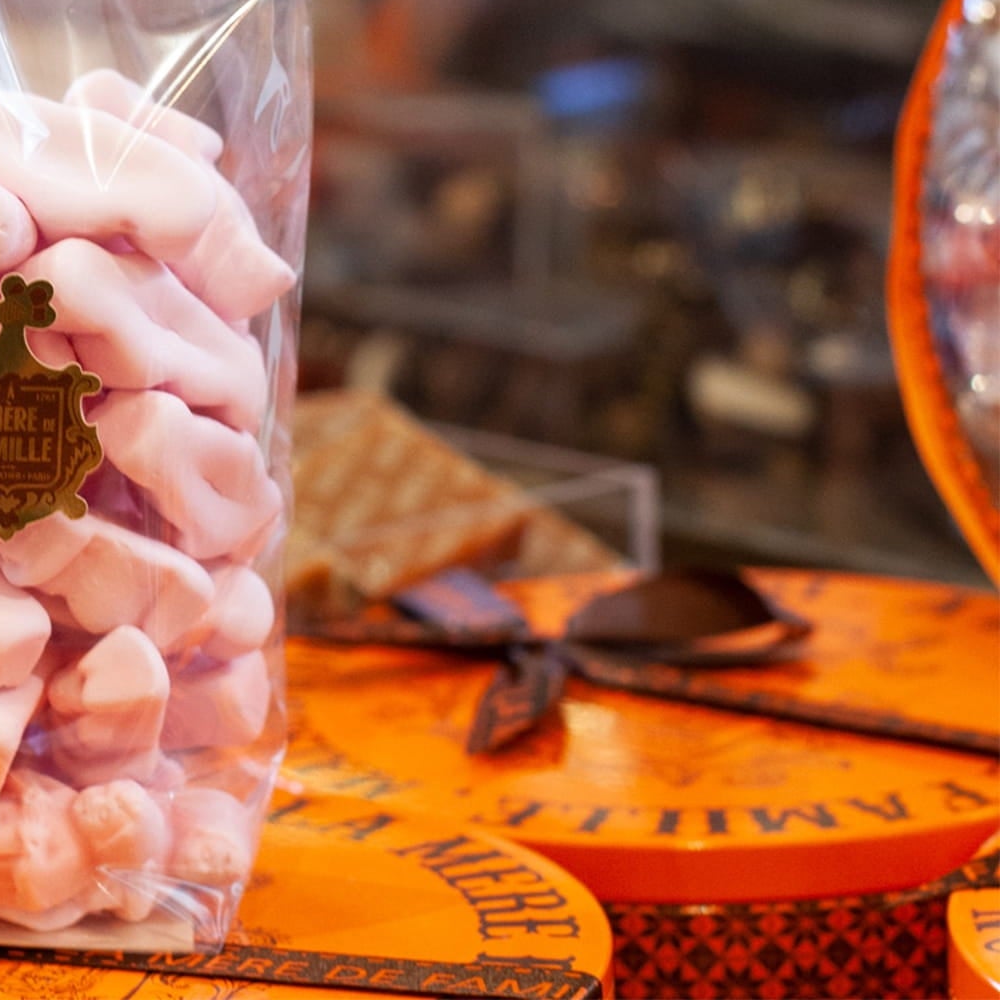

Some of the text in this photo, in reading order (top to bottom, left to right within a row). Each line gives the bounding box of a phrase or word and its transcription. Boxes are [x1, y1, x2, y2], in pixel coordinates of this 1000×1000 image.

[42, 417, 56, 433] DE
[266, 798, 396, 841] LA
[323, 964, 405, 987] DE
